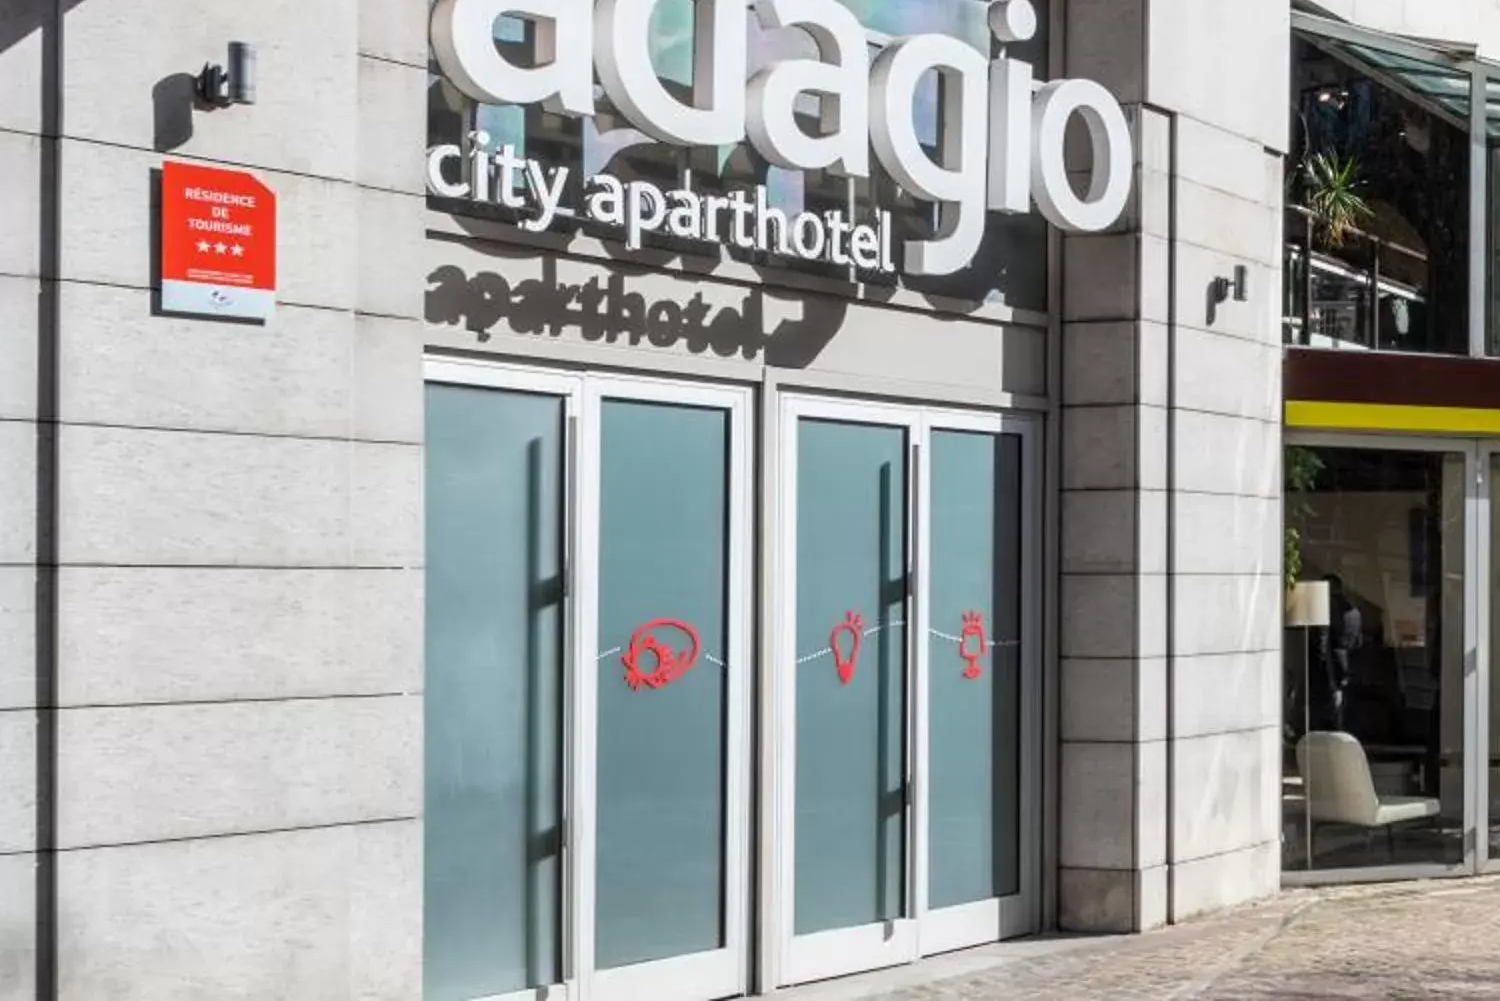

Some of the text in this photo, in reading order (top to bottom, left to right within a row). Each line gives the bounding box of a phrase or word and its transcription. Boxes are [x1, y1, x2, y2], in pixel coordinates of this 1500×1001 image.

[184, 186, 256, 208] RÉSIDENCE
[426, 131, 895, 273] city aparthotel
[211, 206, 230, 219] DE
[187, 217, 253, 236] TOURISME
